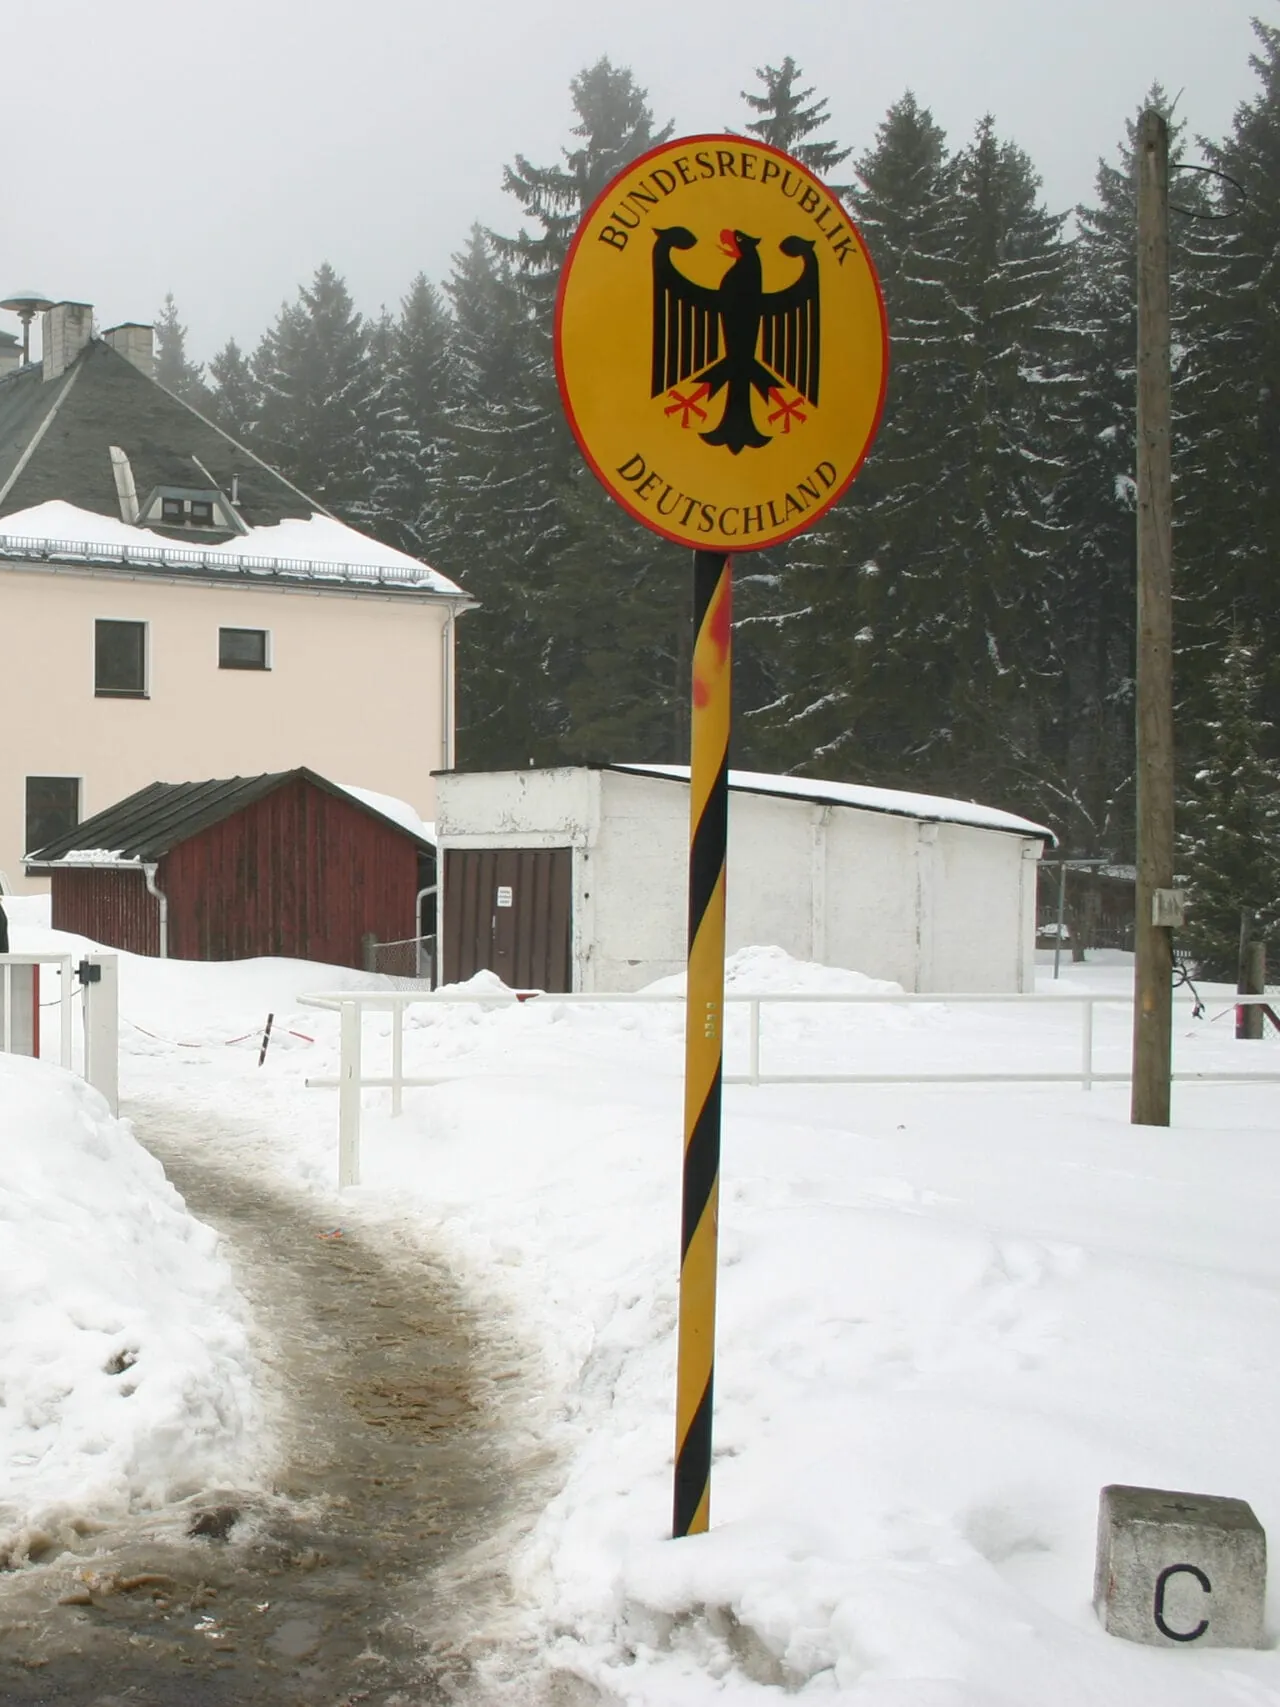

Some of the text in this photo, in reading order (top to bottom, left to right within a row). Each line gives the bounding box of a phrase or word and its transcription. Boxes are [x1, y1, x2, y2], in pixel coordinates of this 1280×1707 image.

[598, 150, 858, 266] BUNDESREPUBLIK
[616, 452, 838, 536] DEUTSCHLAND
[1153, 1563, 1212, 1642] C
